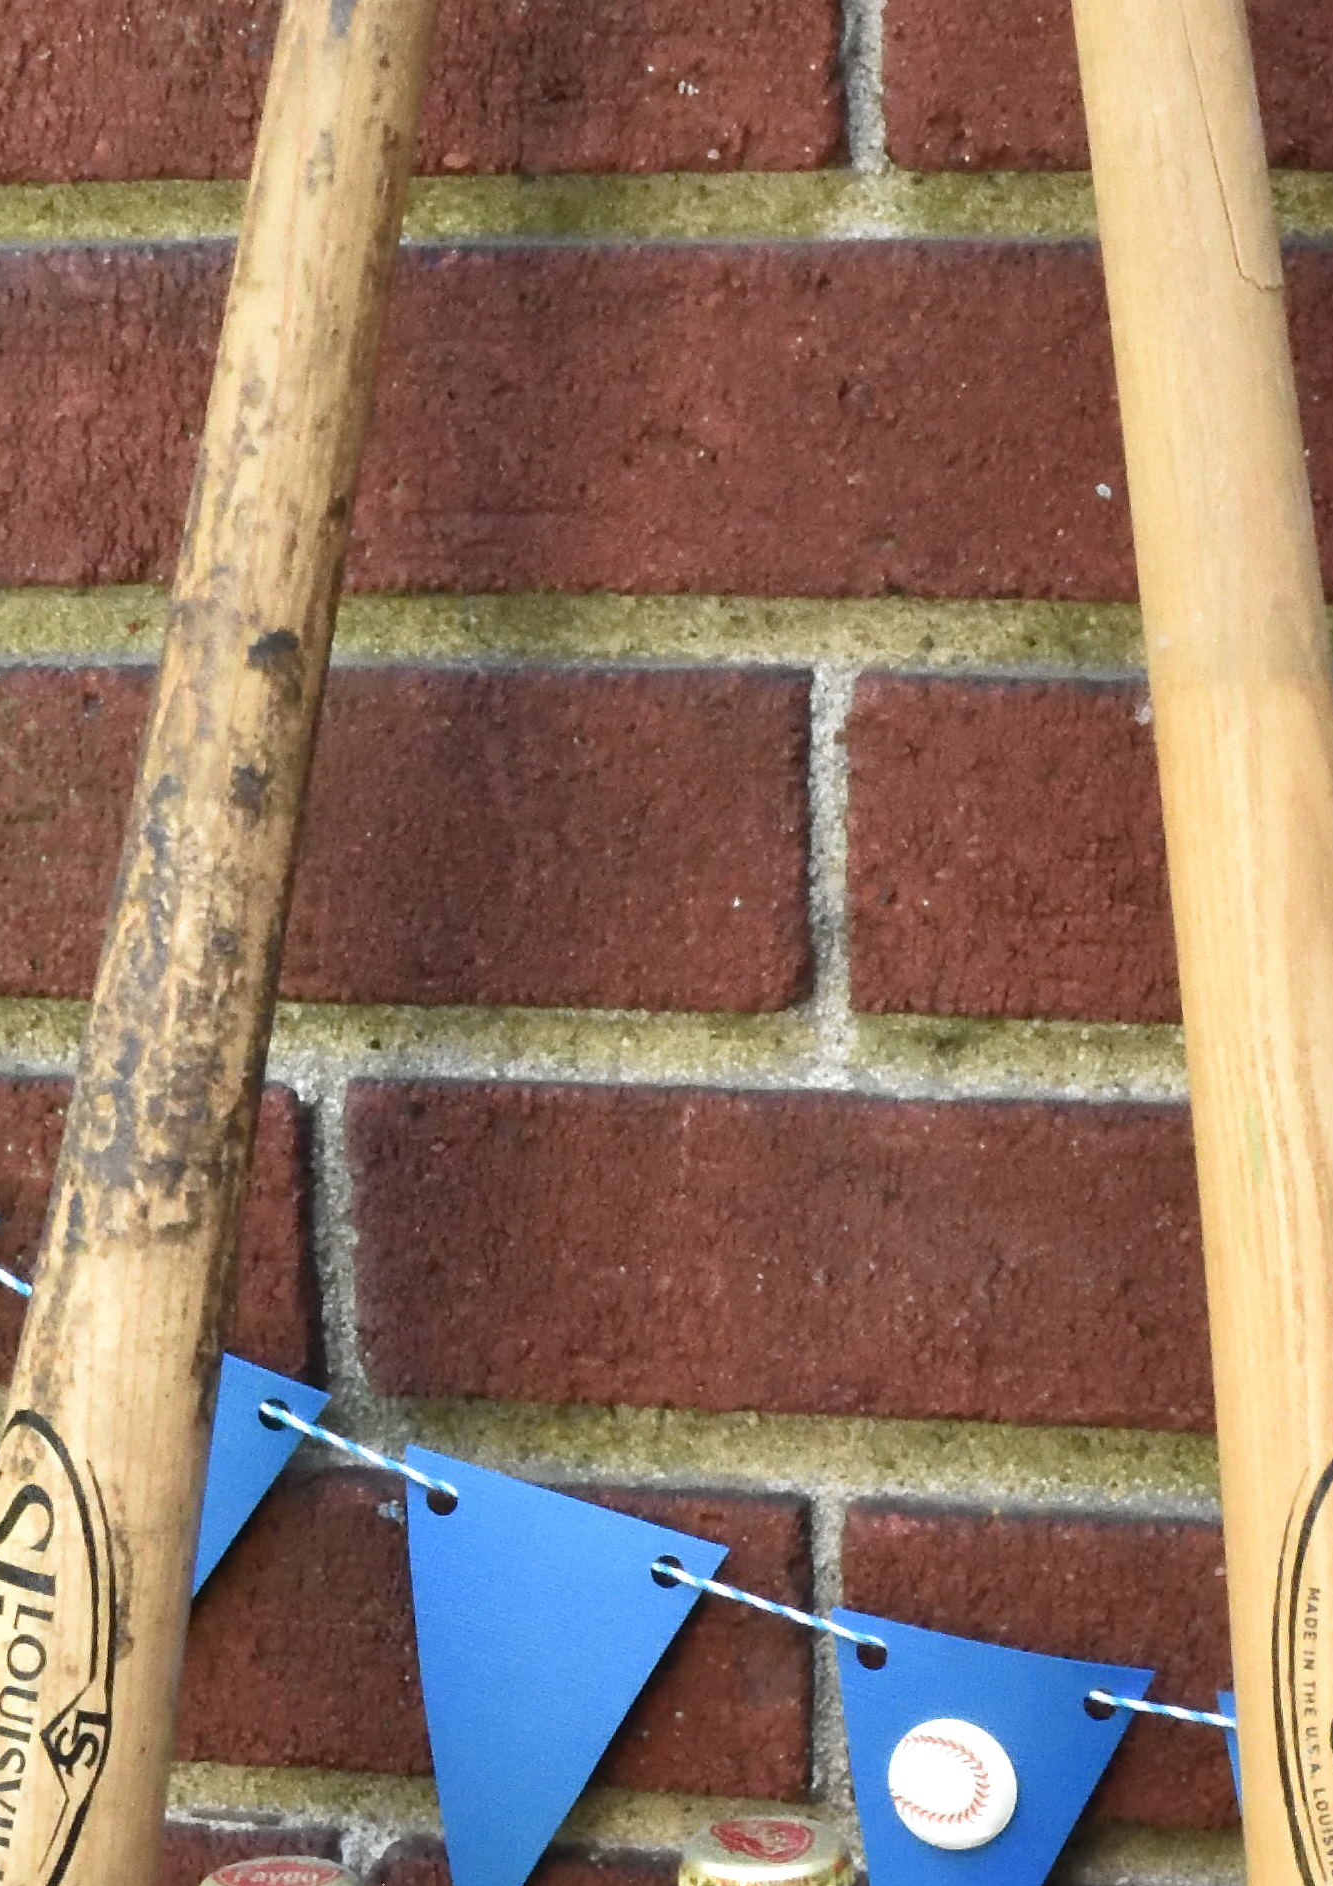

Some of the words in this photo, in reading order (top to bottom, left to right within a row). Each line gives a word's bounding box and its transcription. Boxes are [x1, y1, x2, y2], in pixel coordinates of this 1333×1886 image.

[1303, 1587, 1321, 1641] MADE
[1303, 1649, 1316, 1671] IN
[1304, 1680, 1318, 1717] THE
